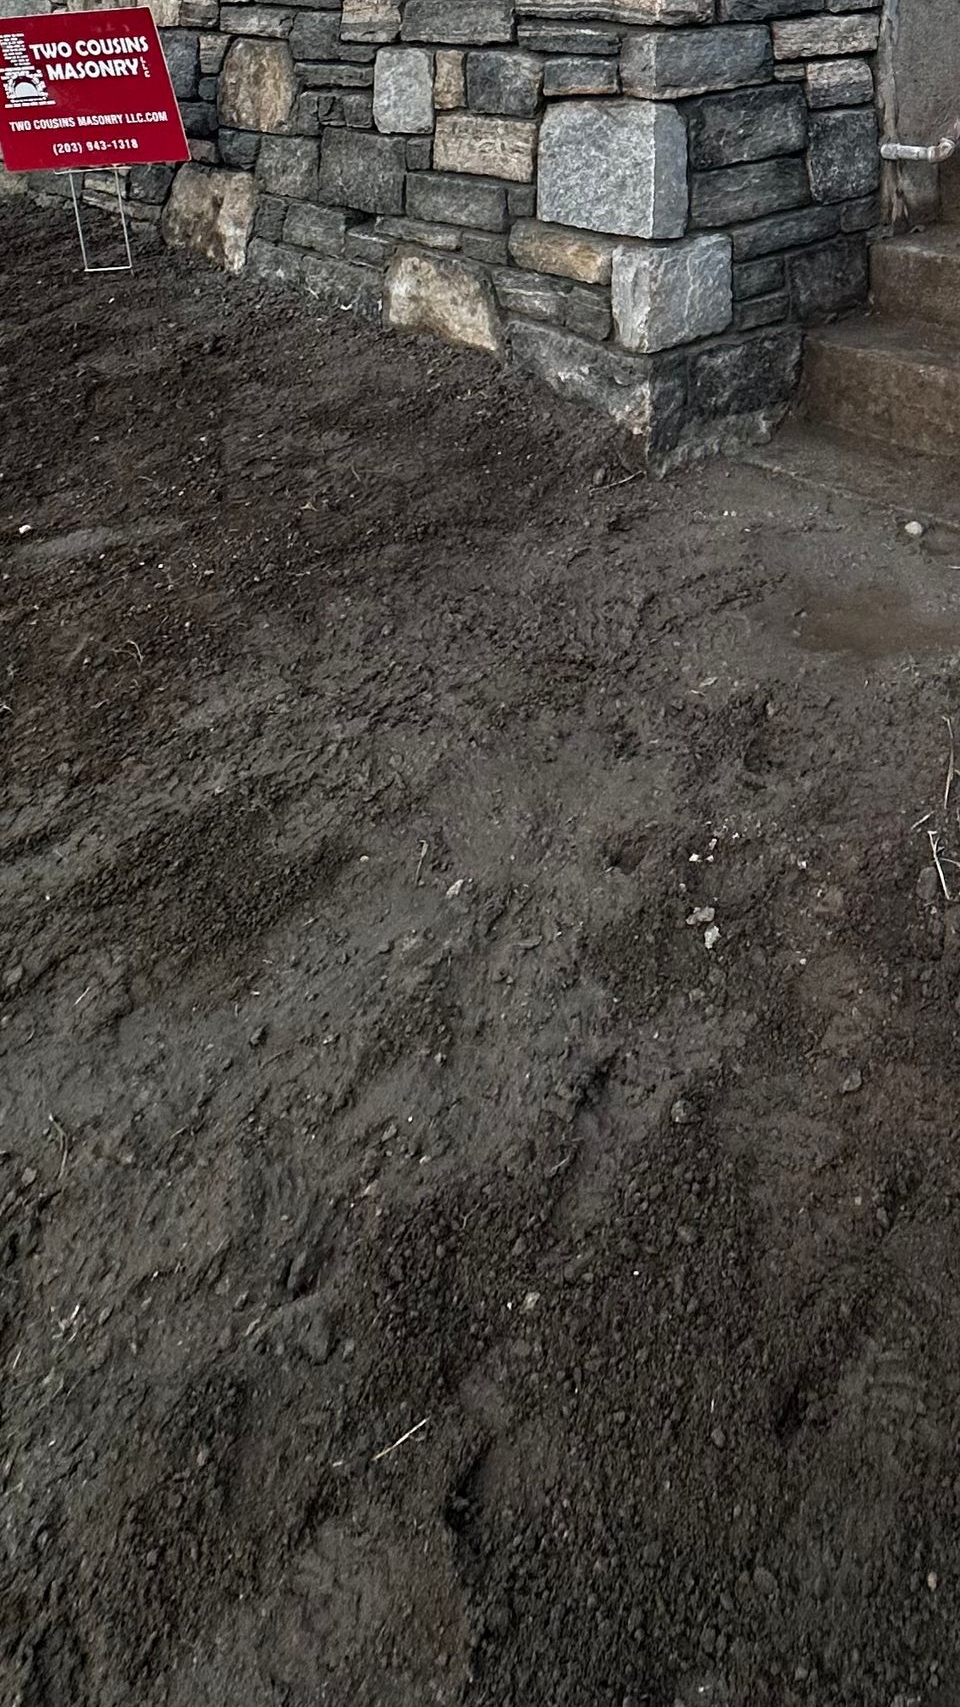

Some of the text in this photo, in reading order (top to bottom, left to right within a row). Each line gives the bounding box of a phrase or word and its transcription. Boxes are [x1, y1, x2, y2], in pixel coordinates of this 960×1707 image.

[29, 36, 149, 60] TWO COUSINS
[46, 58, 139, 81] MASONRY
[140, 57, 151, 78] LLC
[9, 111, 168, 132] TWO COUSINS MASONRY LLC.COM
[52, 142, 83, 156] (203)
